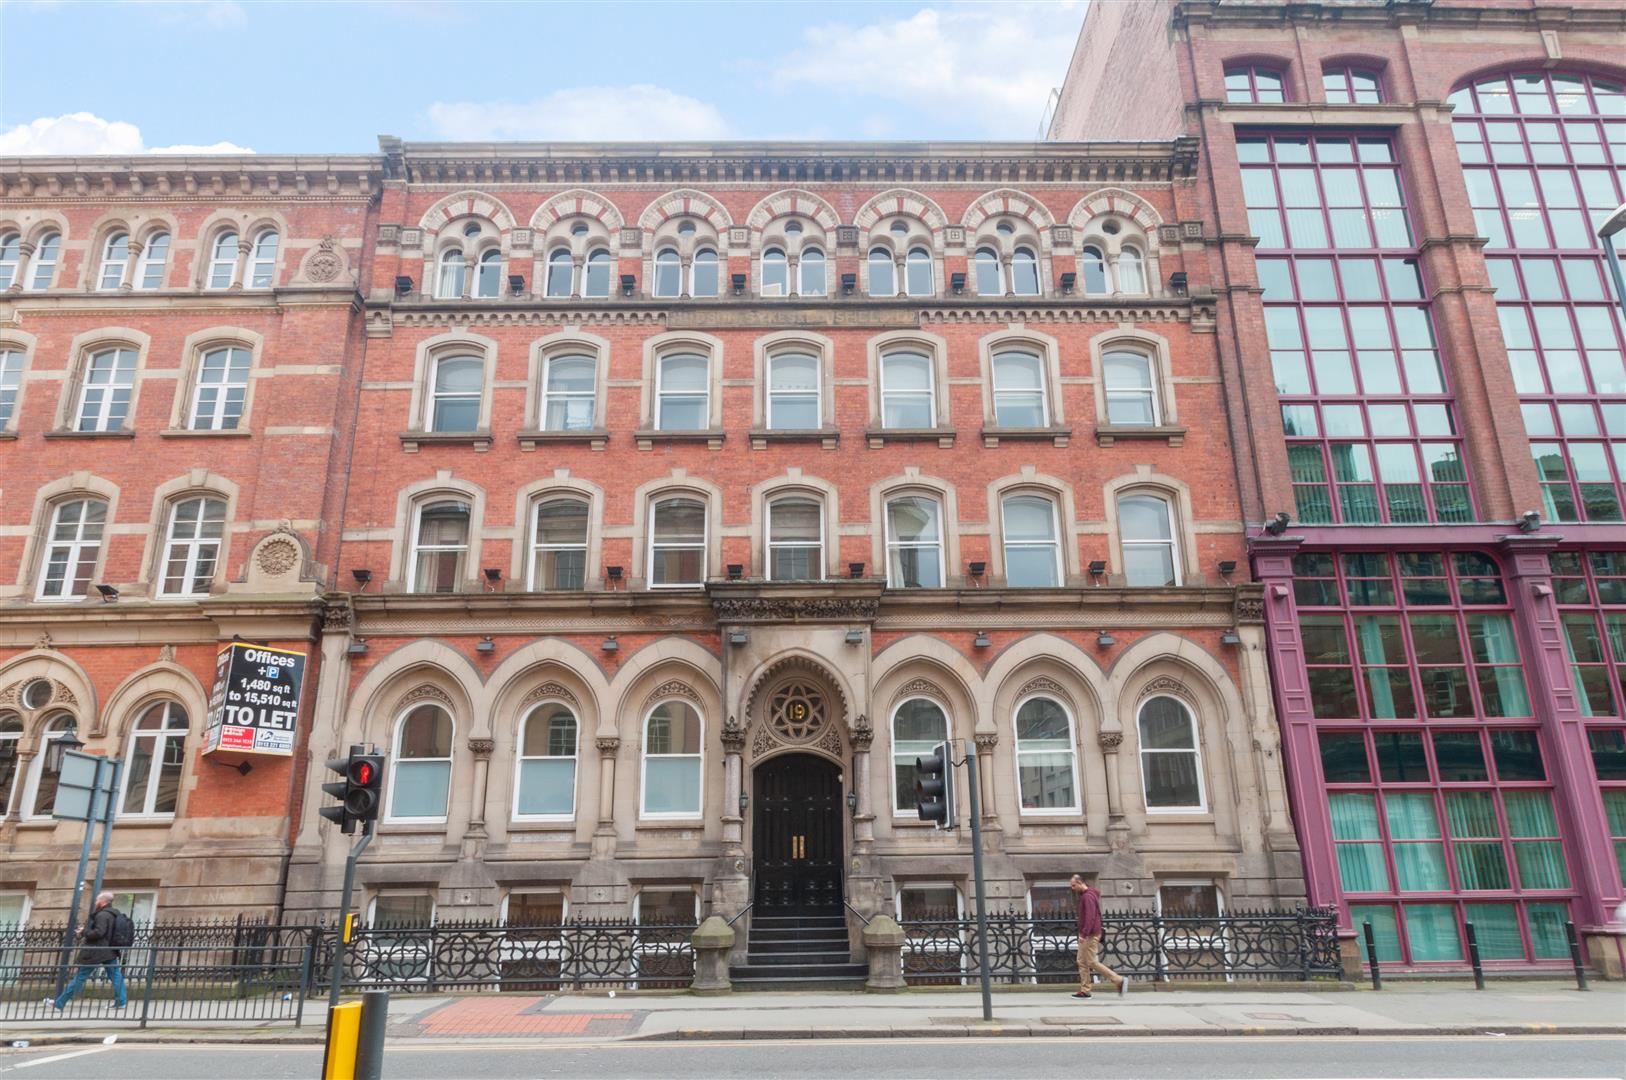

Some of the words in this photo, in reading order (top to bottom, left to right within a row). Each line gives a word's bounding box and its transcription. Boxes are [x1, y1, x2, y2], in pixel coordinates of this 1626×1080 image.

[244, 649, 295, 668] Offices
[241, 678, 271, 691] 1,480
[272, 685, 283, 694] sq
[284, 684, 291, 694] ft
[229, 690, 241, 701] to
[244, 692, 281, 706] 15,510
[282, 700, 291, 708] sq
[226, 705, 254, 726] TO
[258, 709, 297, 730] LET
[790, 704, 805, 719] 19
